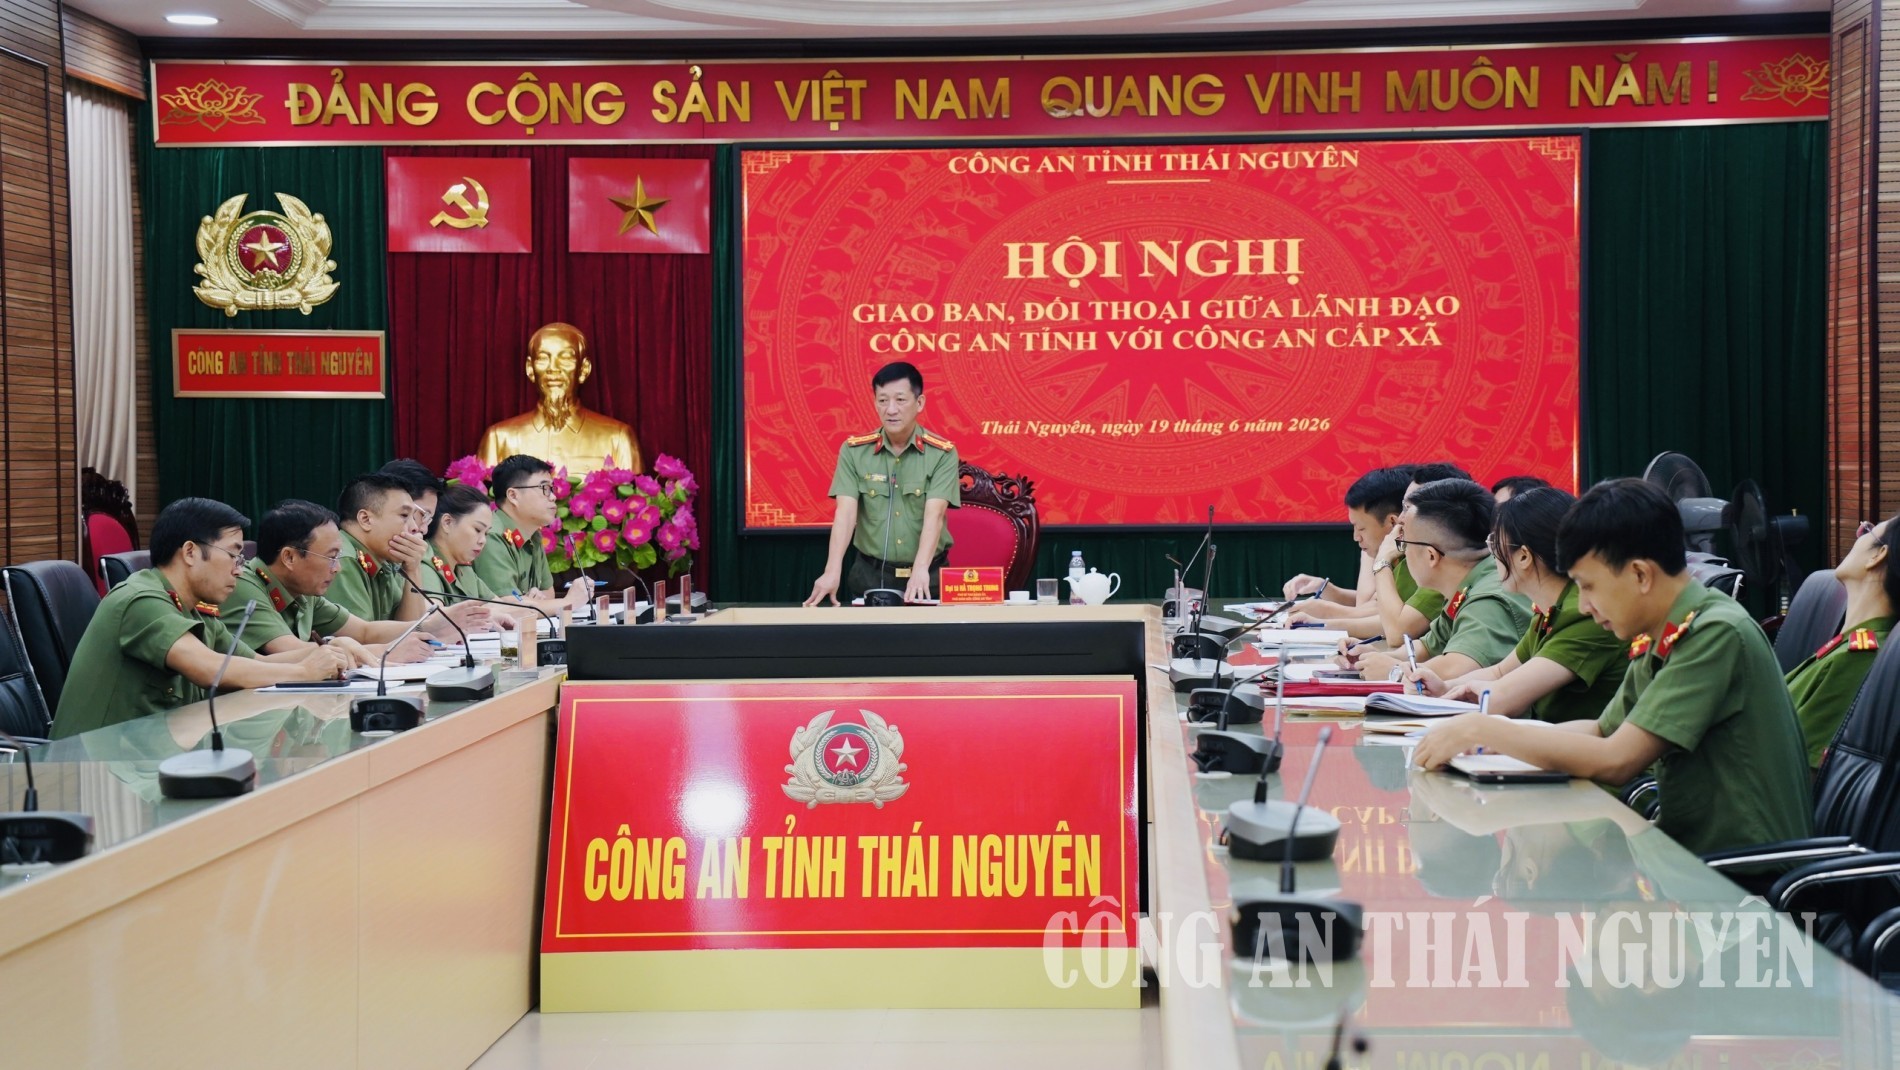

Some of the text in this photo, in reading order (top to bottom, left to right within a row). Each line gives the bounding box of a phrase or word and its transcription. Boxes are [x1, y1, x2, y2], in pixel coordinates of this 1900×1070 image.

[285, 68, 438, 125] ĐẢNG
[466, 72, 625, 134] CỘNG
[651, 65, 750, 122] SẢN
[775, 70, 867, 130] VIỆT
[896, 78, 1010, 119] NAM
[1041, 74, 1225, 118] QUANG
[1245, 72, 1360, 114] VINH
[1386, 56, 1538, 112] MUÔN
[1570, 53, 1690, 107] NĂM
[948, 145, 1359, 174] CÔNG AN TỈNH THÁI NGUYÊN
[1003, 235, 1304, 288] HỘI NGHỊ
[853, 293, 1460, 325] GIAO BAN, ĐỐI THOẠI GIỮA LÃNH ĐẠO
[869, 321, 1442, 353] CÔNG AN TỈNH VỚI CÔNG AN CẤP XÃ
[188, 344, 374, 376] CÔNG AN TỈNH THÁI NGUYÊN
[980, 417, 1330, 437] Thái Nguyên, ngày 19 tháng 6 năm 2026
[584, 814, 1101, 902] CÔNG AN TỈNH THÁI NGUYÊN
